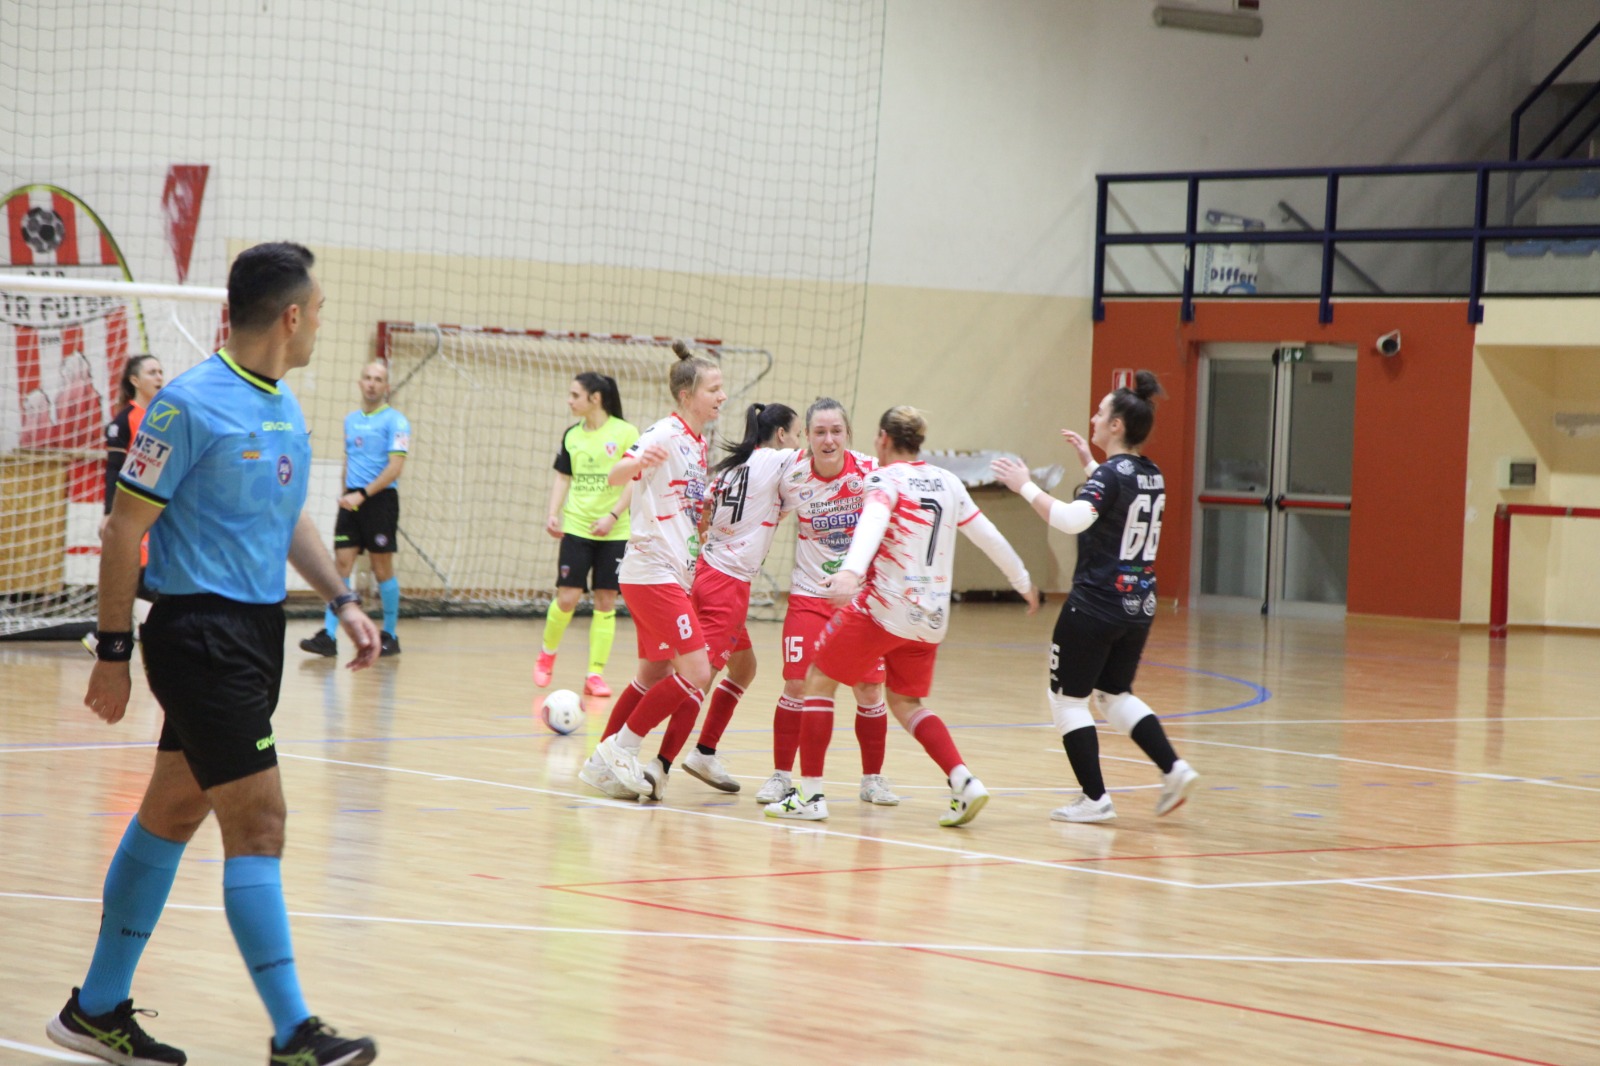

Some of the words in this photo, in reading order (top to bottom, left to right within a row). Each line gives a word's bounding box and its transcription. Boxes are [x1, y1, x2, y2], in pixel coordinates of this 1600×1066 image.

[920, 498, 943, 566] 7
[1119, 494, 1166, 561] 66
[676, 613, 693, 640] 8
[784, 636, 804, 663] 15
